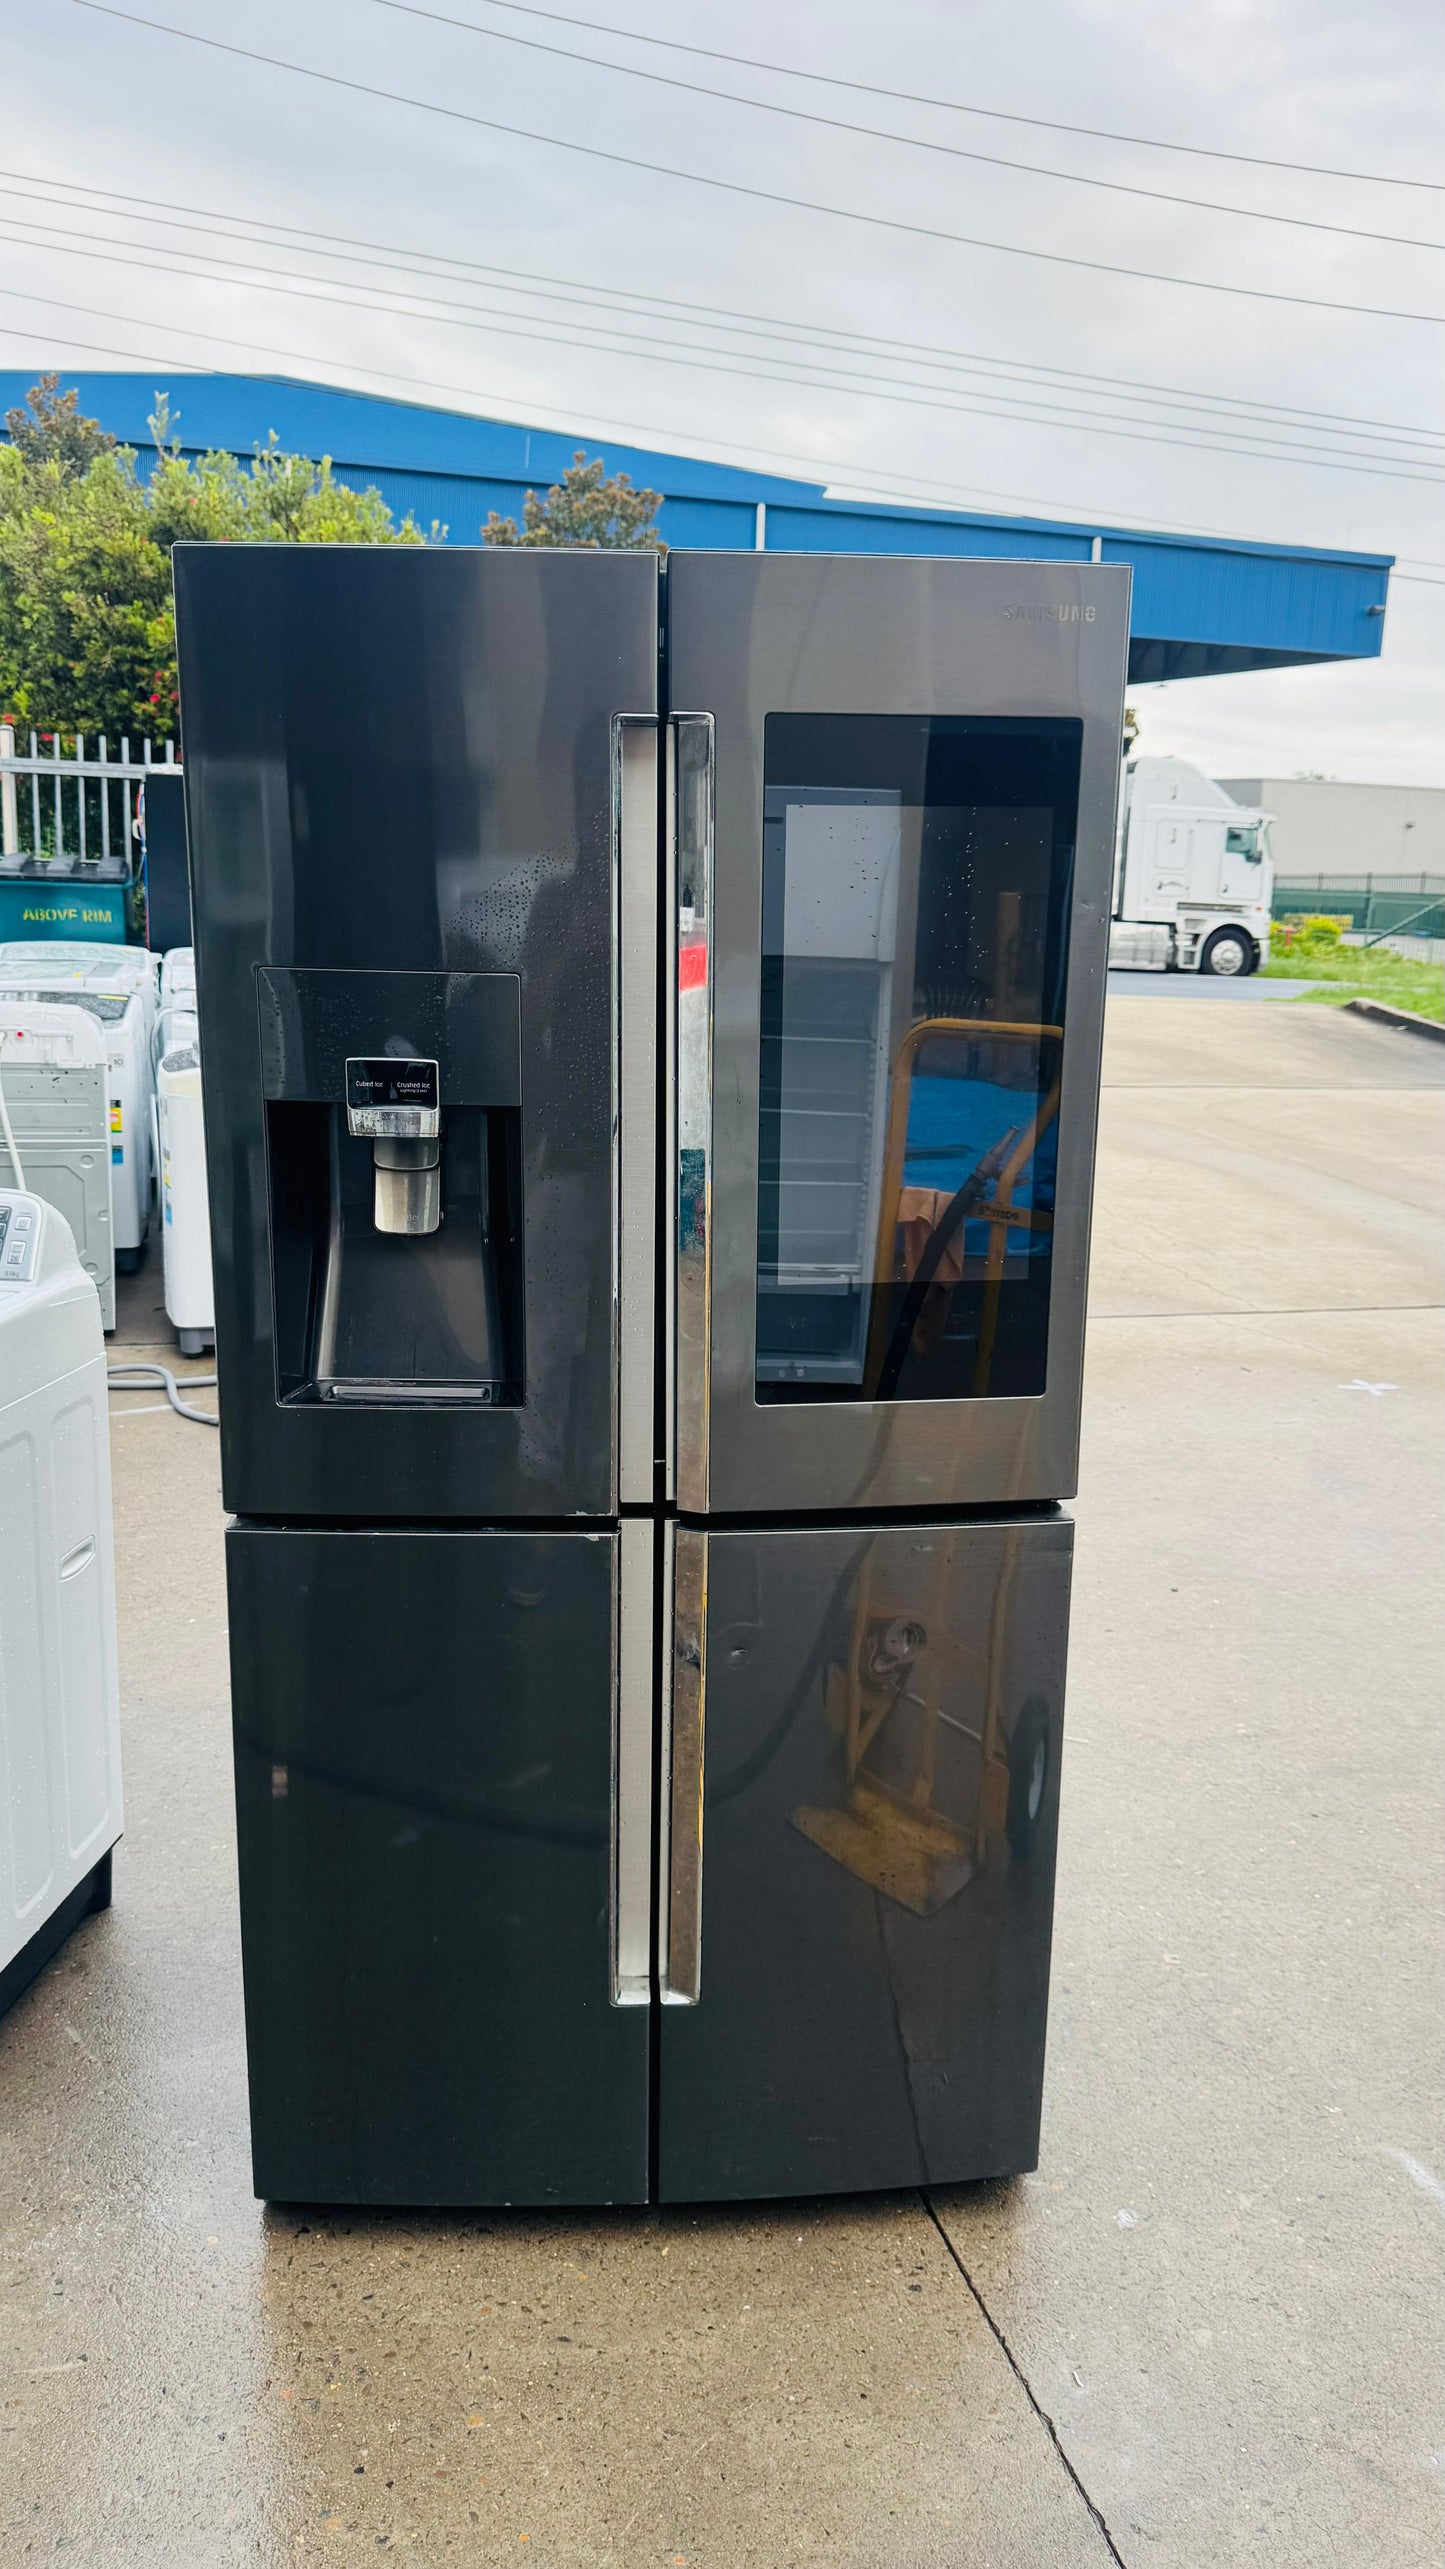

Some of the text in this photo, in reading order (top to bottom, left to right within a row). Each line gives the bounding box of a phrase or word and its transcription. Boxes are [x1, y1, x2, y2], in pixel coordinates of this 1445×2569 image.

[1003, 604, 1096, 622] SAMSUNG
[355, 1080, 374, 1088] Cubed
[396, 1081, 421, 1089] Crushed
